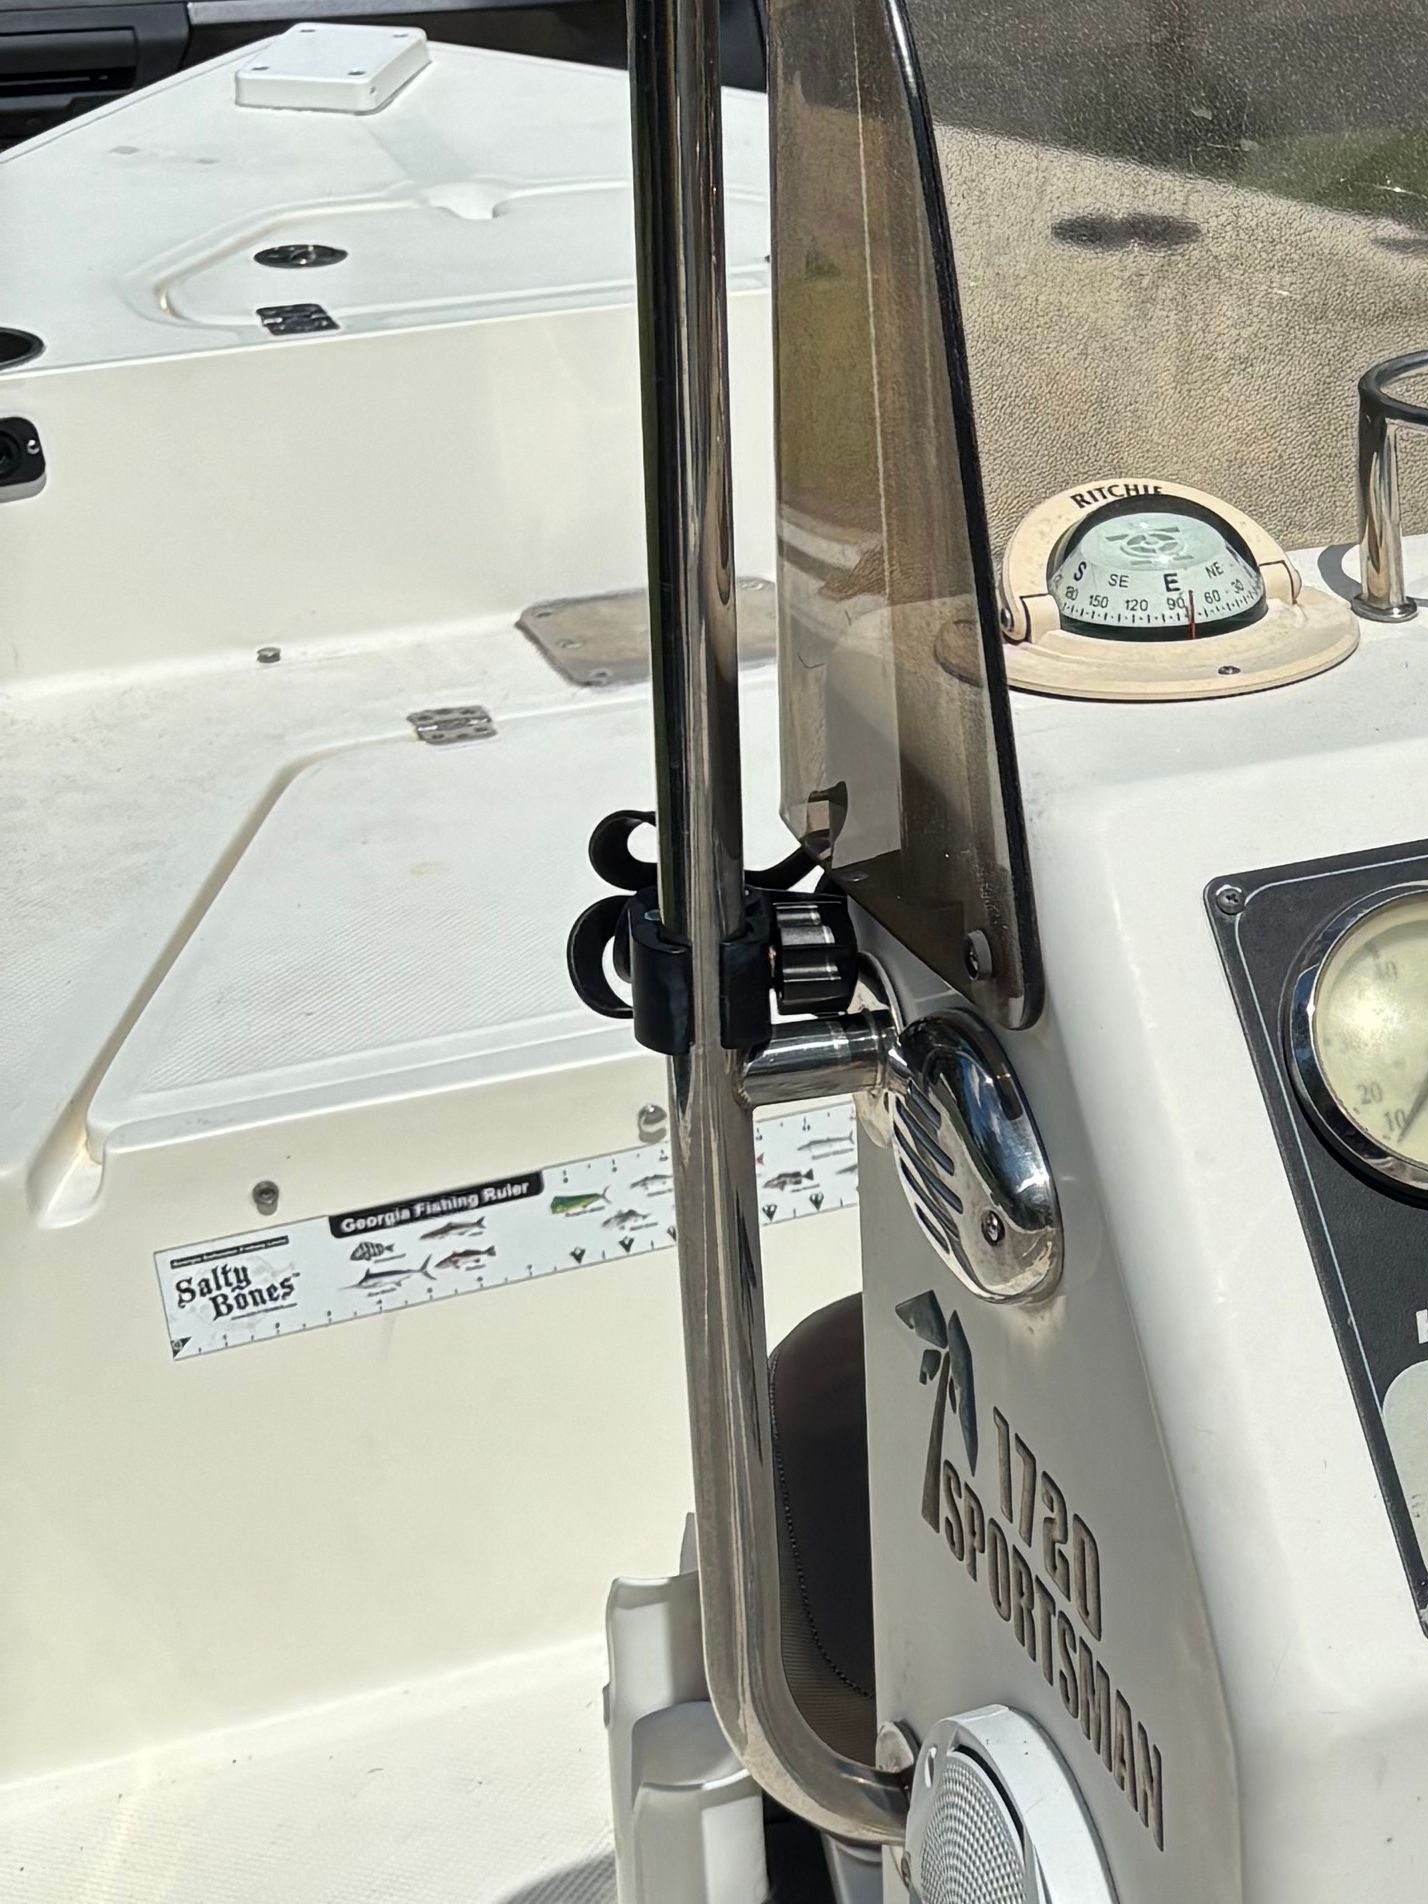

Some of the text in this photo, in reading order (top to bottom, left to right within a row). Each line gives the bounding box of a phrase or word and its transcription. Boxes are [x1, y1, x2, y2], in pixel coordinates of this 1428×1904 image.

[1069, 483, 1162, 509] RITCHIE
[1073, 560, 1224, 593] S SE E NE
[1088, 594, 1109, 609] 150
[1124, 598, 1149, 612] 120
[1166, 596, 1185, 610] 90
[1204, 589, 1221, 604] 60
[1355, 1080, 1384, 1105] 20
[1384, 1108, 1406, 1133] 10
[340, 1182, 530, 1233] Georgia Fishing Ruler
[175, 1263, 252, 1309] Salty
[208, 1276, 296, 1321] Bones
[993, 1405, 1102, 1643] 1720
[942, 1459, 1164, 1853] SPORTSMAN
